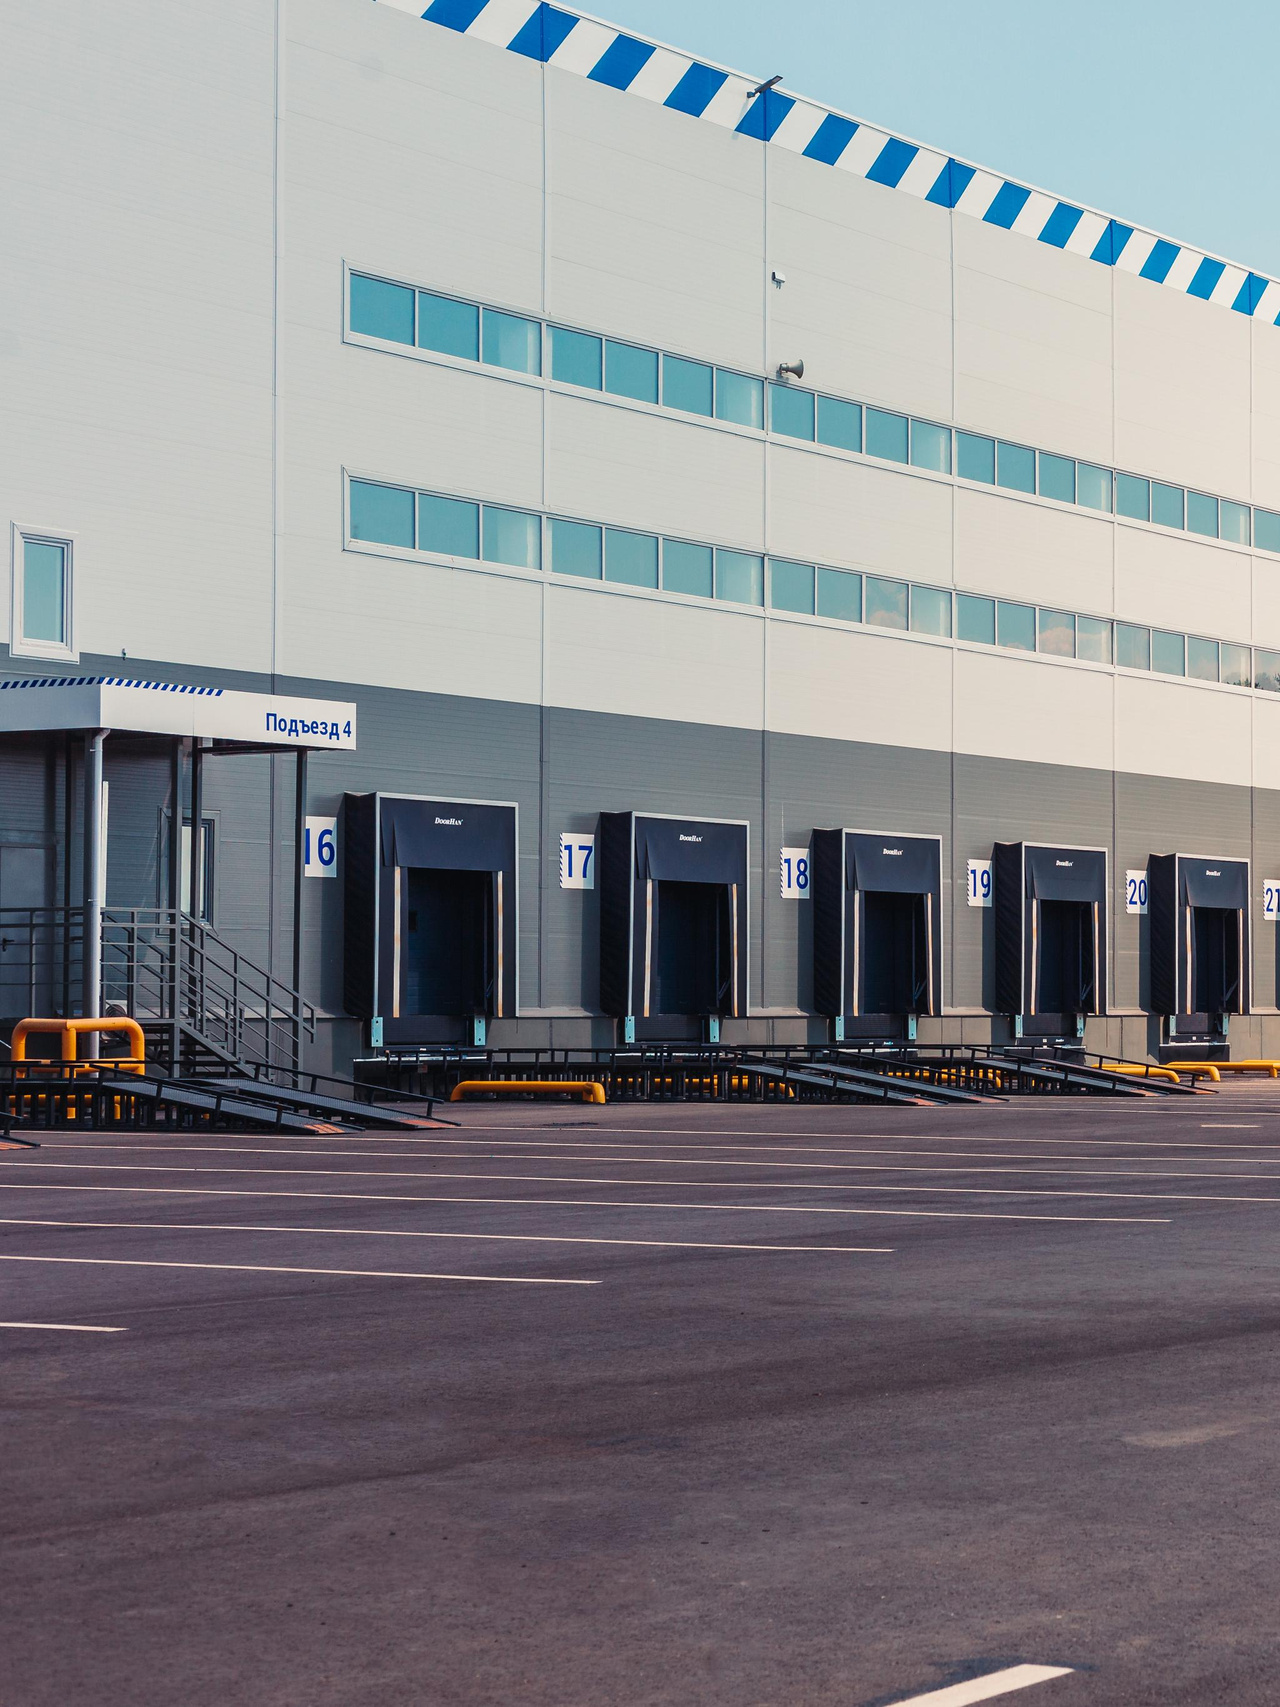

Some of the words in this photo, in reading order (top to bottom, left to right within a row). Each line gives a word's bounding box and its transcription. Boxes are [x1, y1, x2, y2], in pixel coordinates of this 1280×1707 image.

[266, 712, 340, 741] Подъезд
[343, 720, 352, 738] 4
[304, 828, 335, 866] 16
[563, 844, 594, 879] 17
[784, 858, 809, 890] 18
[970, 869, 991, 899] 19
[1128, 878, 1148, 906] 20
[1265, 887, 1280, 913] 21
